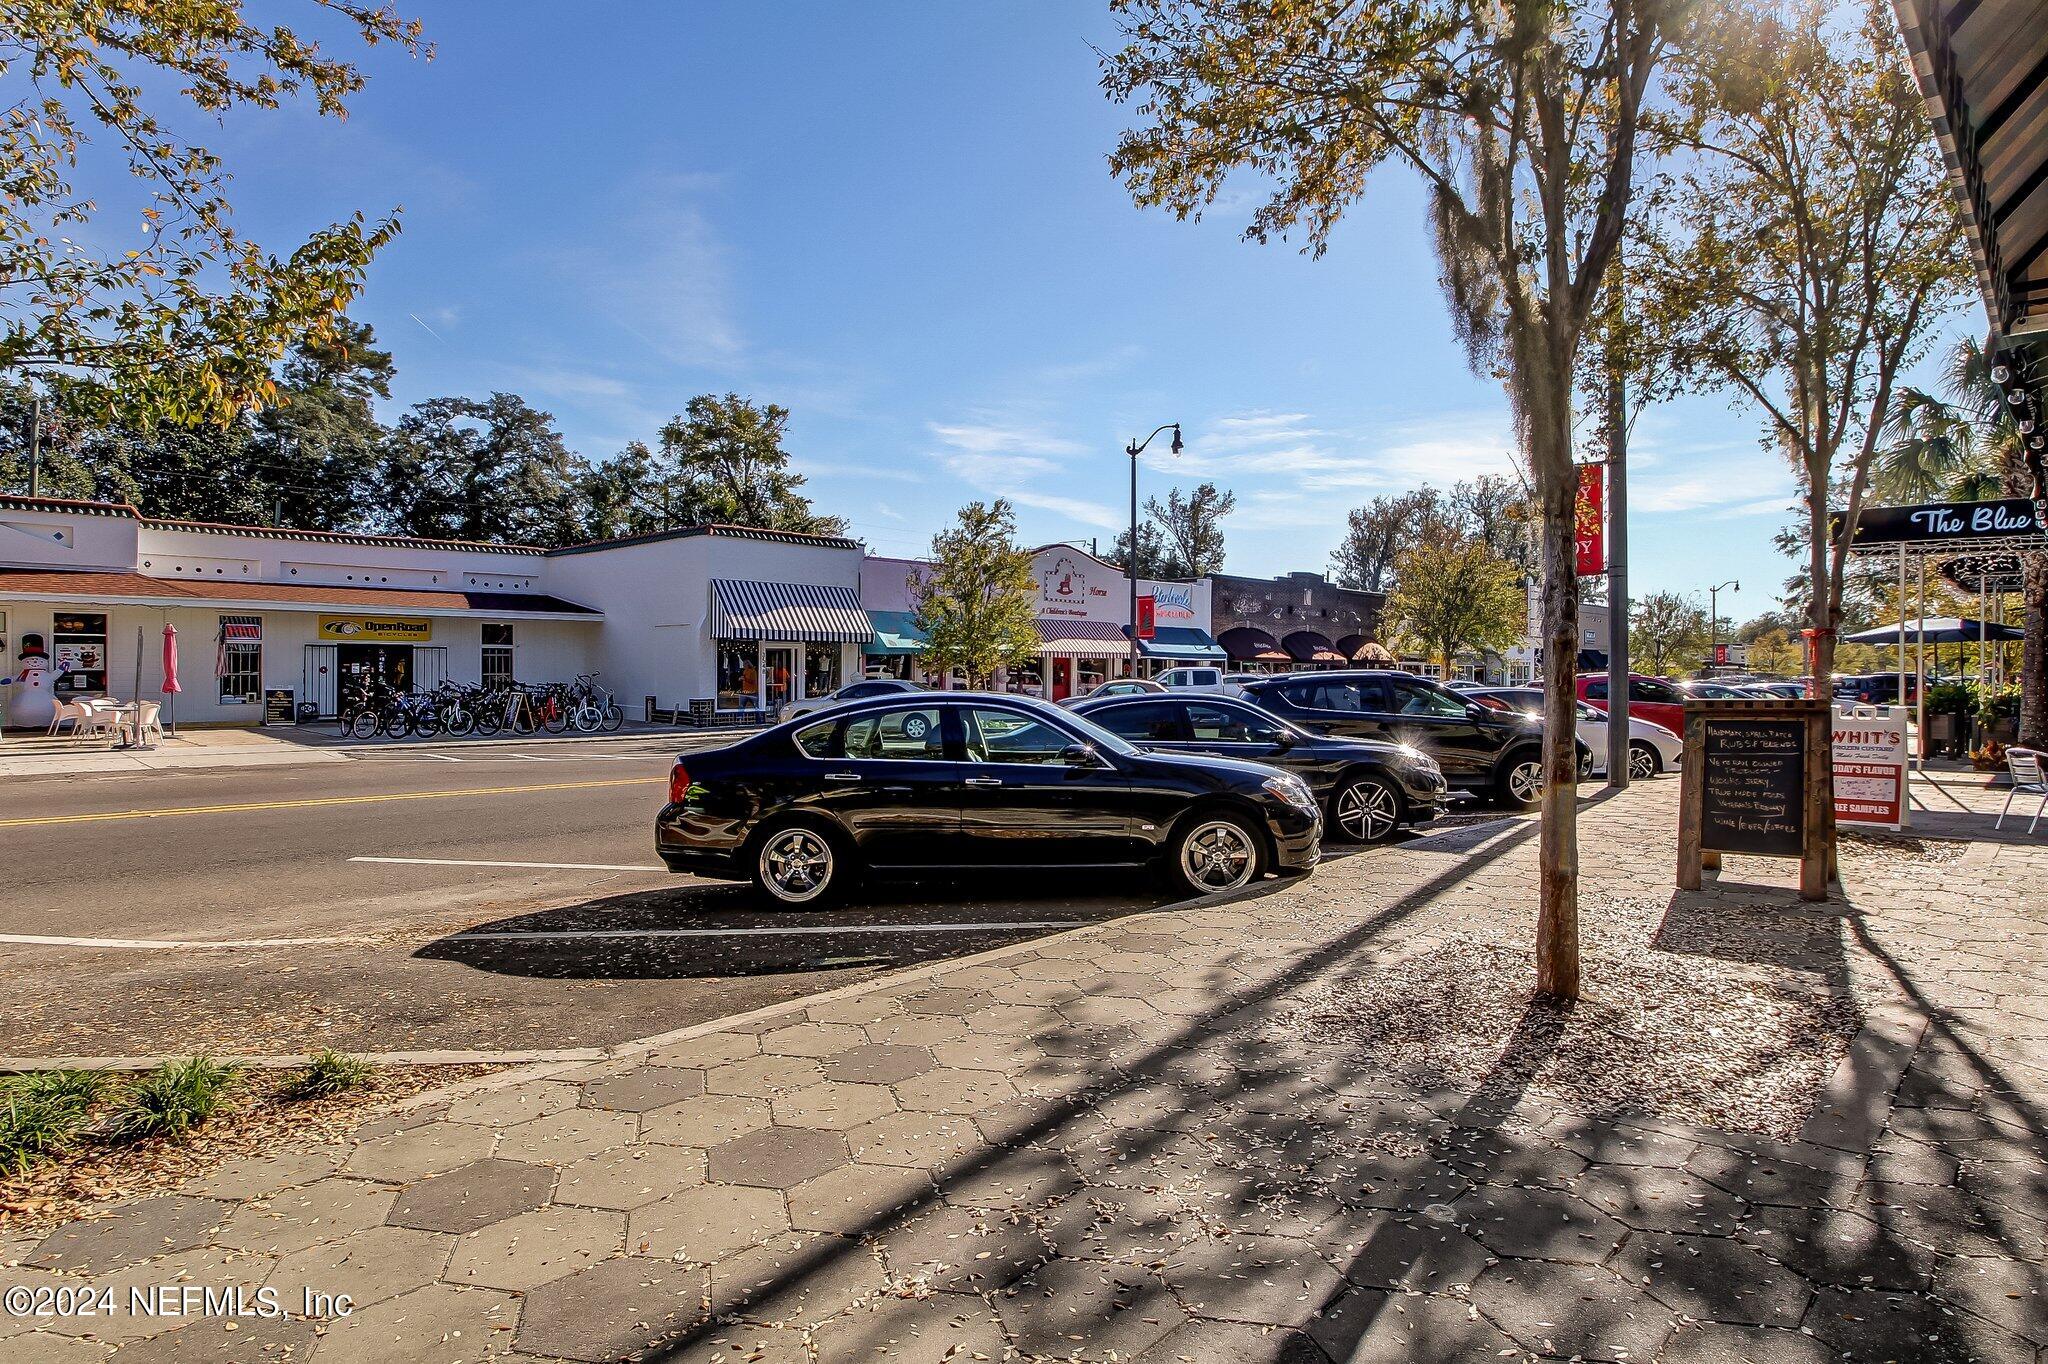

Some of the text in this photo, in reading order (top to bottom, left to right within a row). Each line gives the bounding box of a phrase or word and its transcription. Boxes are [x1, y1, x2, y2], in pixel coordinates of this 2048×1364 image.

[1910, 505, 2031, 533] The Blue
[364, 621, 428, 632] OpenRoad
[1831, 729, 1900, 745] WHIT'S
[1832, 764, 1896, 776] ODAY'S FLAVOR
[1834, 802, 1890, 815] REE SAMPLES
